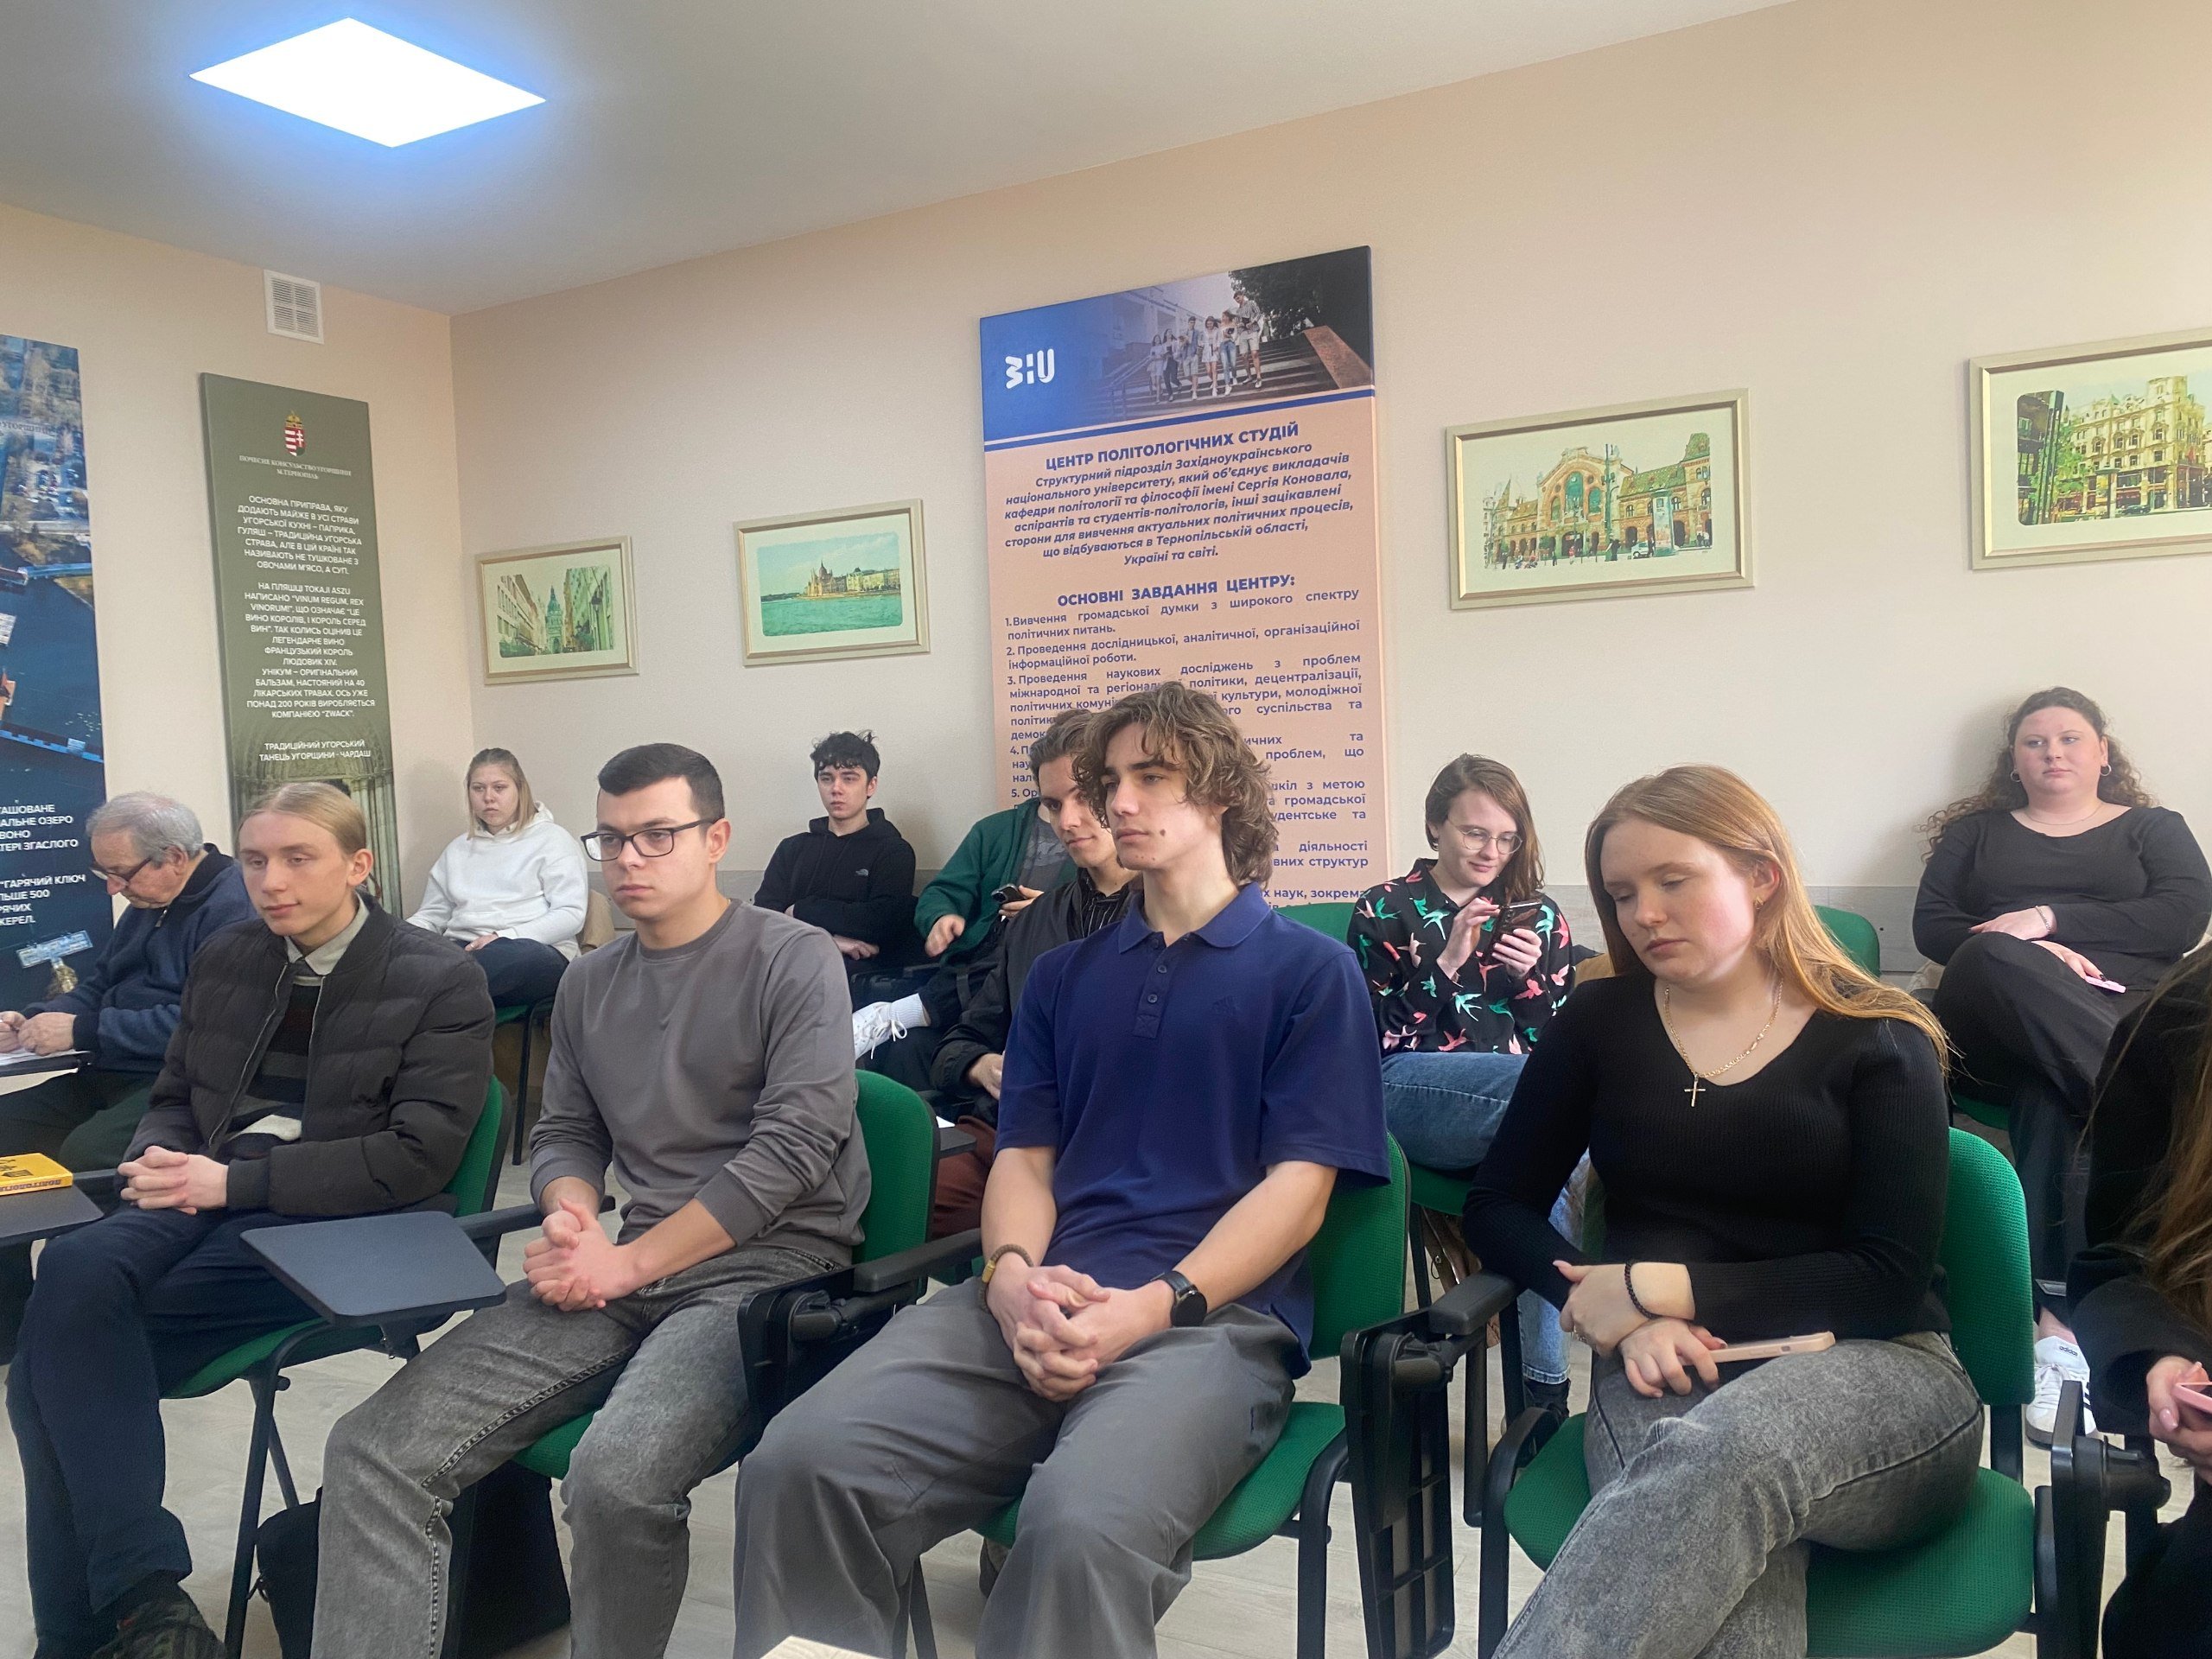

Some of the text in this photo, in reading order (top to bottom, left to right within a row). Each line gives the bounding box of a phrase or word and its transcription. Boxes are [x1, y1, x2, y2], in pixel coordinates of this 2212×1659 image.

[1046, 421, 1299, 471] ЦЕНТР ПОЛІТОЛОГІЧНИХ СТУДІЙ
[1035, 443, 1313, 488] Структурний підрозділ Західноукраїнського
[1006, 488, 1090, 505] національного
[1093, 477, 1175, 497] університету,
[1179, 470, 1210, 484] який
[1272, 452, 1350, 472] викладачів
[1004, 470, 1351, 519] кафедри політології та філософії імені Сергія Коновала,
[1014, 516, 1075, 532] аспірантів
[1093, 498, 1228, 524] студентів-політологів,
[1231, 493, 1259, 507] інші
[1262, 483, 1342, 504] зацікавлені
[1005, 499, 1353, 548] сторони для вивчення актуальних політичних процесів,
[1043, 518, 1308, 557] що відбуваються в Тернопільській області,
[1124, 545, 1218, 567] Україні та світі.
[1058, 574, 1295, 607] ОСНОВНІ ЗАВДАННЯ ЦЕНТРУ:
[1078, 605, 1149, 622] громадської
[1160, 603, 1198, 616] думки
[1211, 601, 1217, 610] з
[1230, 595, 1293, 608] широкого
[1306, 589, 1359, 601] спектру
[1007, 626, 1116, 640] політичних питань.
[1018, 643, 1086, 657] Проведення
[1091, 633, 1179, 651] дослідницької,
[1183, 627, 1259, 643] аналітичної,
[1264, 620, 1360, 639] організаційної
[1008, 652, 1136, 671] інформаційної роботи.
[1019, 673, 1087, 686] Проведення
[1106, 668, 1160, 680] наукових
[1180, 662, 1254, 675] досліджень
[1303, 653, 1361, 668] проблем
[1009, 685, 1081, 698] міжнародної
[1190, 677, 1248, 688] політики,
[1255, 667, 1362, 685] децентралізації,
[1010, 702, 1073, 712] політичних
[1077, 697, 1117, 709] комуні
[1222, 690, 1281, 702] культури,
[1286, 683, 1363, 697] молодіжної
[1256, 702, 1332, 715] суспільства
[1348, 701, 1363, 709] та
[1011, 731, 1046, 741] демок
[1244, 736, 1282, 745] ичних
[1349, 733, 1363, 741] та
[1266, 748, 1364, 761] проблем, що
[1323, 780, 1365, 789] метою
[1285, 793, 1366, 807] громадської
[0, 816, 73, 827] АЛЬНЕ ОЗЕРО
[1351, 810, 1366, 819] та
[0, 839, 79, 851] ТЕРІ ЗГАСЛОГО
[1299, 840, 1368, 853] діяльності
[1308, 858, 1369, 868] структур
[54, 874, 86, 884] КЛЮЧ
[29, 889, 50, 899] 500
[1274, 890, 1306, 899] наук,
